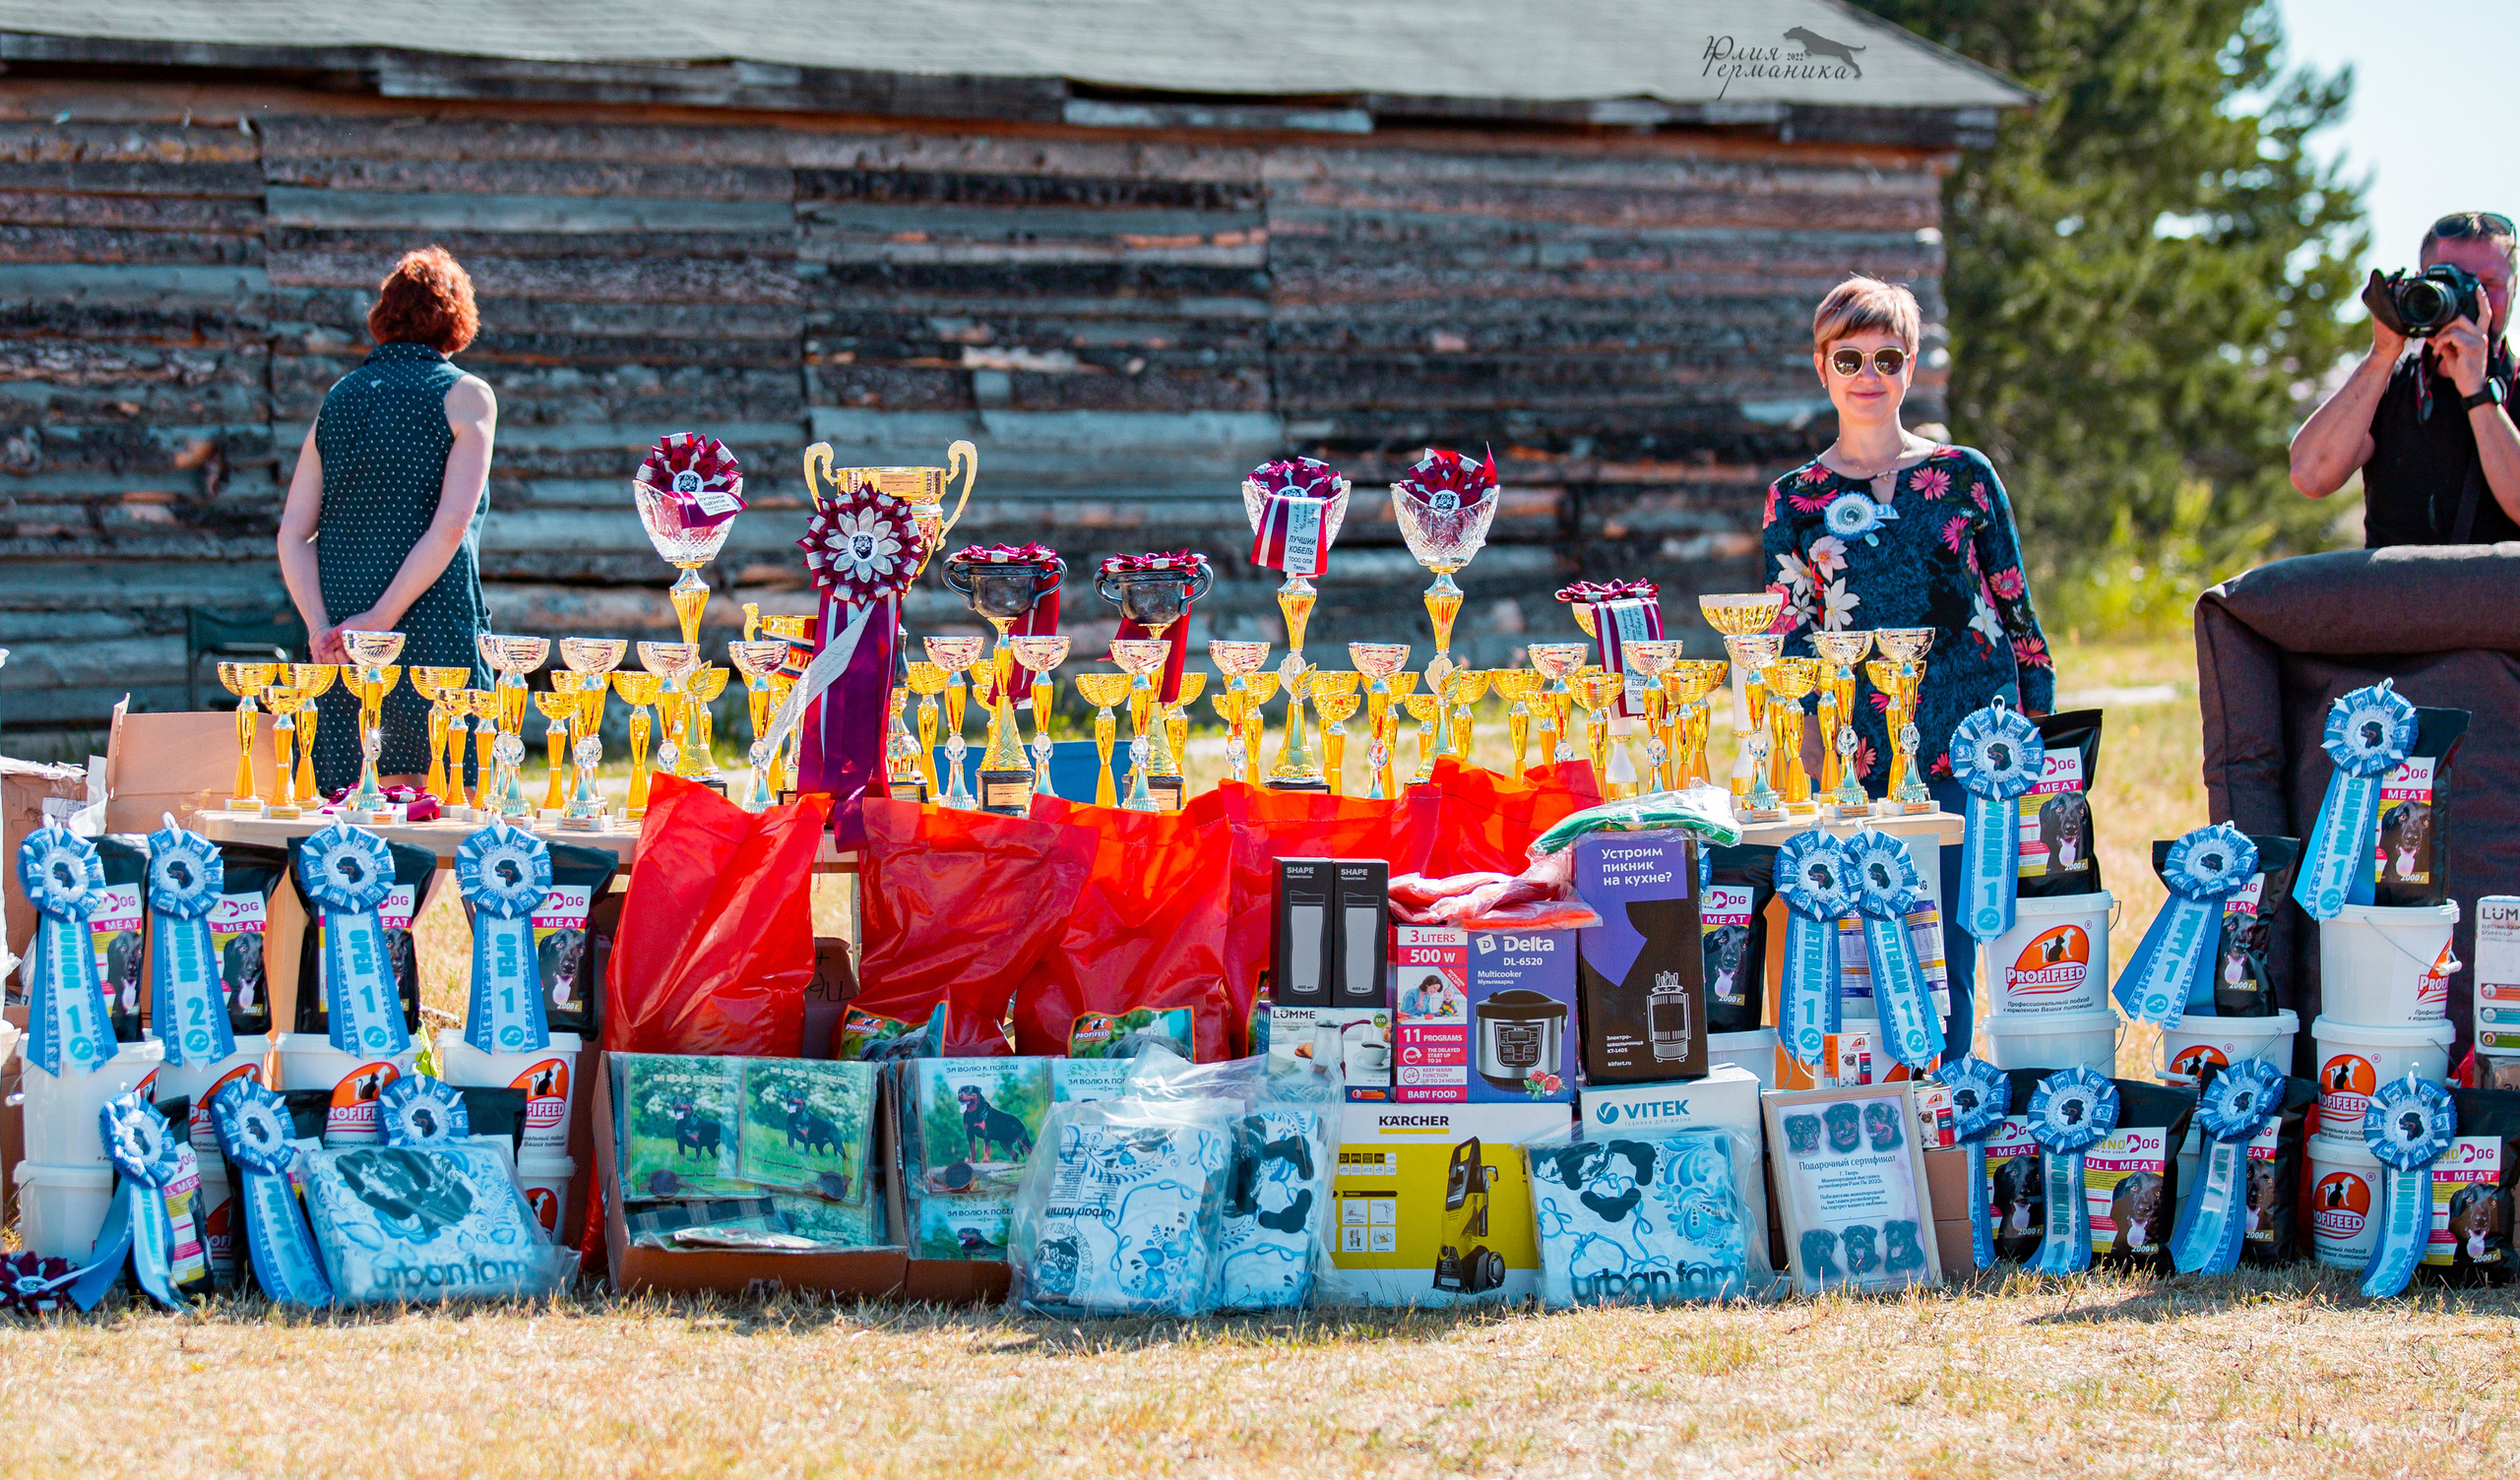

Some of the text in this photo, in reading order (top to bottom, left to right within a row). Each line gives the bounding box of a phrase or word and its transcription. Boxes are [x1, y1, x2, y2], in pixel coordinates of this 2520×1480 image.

[1289, 534, 1316, 545] ЛУЧШИЙ
[1289, 545, 1314, 556] КОБЕЛЬ
[2040, 780, 2079, 793] MEAT
[2387, 790, 2426, 799] MEAT
[2333, 778, 2365, 856] CHAMPION
[1982, 801, 2005, 878] WORKING
[1602, 847, 1664, 860] Устроим
[1603, 861, 1655, 873] пикник
[2332, 859, 2346, 886] 1
[1604, 872, 1672, 887] на кухне?
[1984, 882, 1997, 906] 1
[382, 917, 410, 926] EAT
[1707, 915, 1746, 924] MEAT
[2482, 907, 2518, 920] LÜM
[105, 918, 140, 931] MEAT
[222, 921, 263, 932] MEAT
[542, 917, 584, 927] MEAT
[1410, 930, 1456, 943] 3 LITERS
[2170, 908, 2204, 959] PUPPY
[1503, 935, 1554, 952] Delta
[348, 929, 374, 975] OPEN
[495, 933, 518, 977] OPEN
[1410, 949, 1456, 963] 500 W
[1802, 919, 1824, 993] VETERAN
[1879, 920, 1911, 994] VETERAN
[1503, 957, 1543, 966] DL-6520
[2005, 965, 2087, 984] PROFIFEED
[2164, 959, 2179, 983] 1
[359, 985, 376, 1014] 1
[500, 987, 514, 1014] 1
[556, 1002, 574, 1011] 2000
[2008, 999, 2068, 1008] Профессиональный
[66, 1005, 82, 1033] 1
[187, 997, 206, 1025] 2
[1802, 998, 1815, 1025] 1
[1900, 1000, 1916, 1027] 1
[846, 1023, 879, 1033] PROFIFEED
[1076, 1030, 1110, 1039] PROFIFEED
[1404, 1028, 1420, 1042] 11
[527, 1102, 566, 1118] FIFEED
[1623, 1099, 1690, 1119] VITEK
[2321, 1094, 2369, 1112] OFIFEED
[1379, 1116, 1449, 1126] KÄRCHER
[1996, 1145, 2036, 1156] MEAT
[2246, 1147, 2271, 1157] EAT
[1799, 1154, 1896, 1171] Подарочный сертификат
[2086, 1157, 2160, 1171] ULL MEAT
[2454, 1172, 2494, 1182] MEAT
[2050, 1153, 2071, 1236] WORKING
[2393, 1170, 2417, 1235] JUNIOR
[2315, 1210, 2364, 1230] OFIFEED
[2018, 1227, 2036, 1236] 2000
[2053, 1240, 2065, 1265] 1
[2386, 1247, 2408, 1272] 2
[1676, 1262, 1740, 1283] fam
